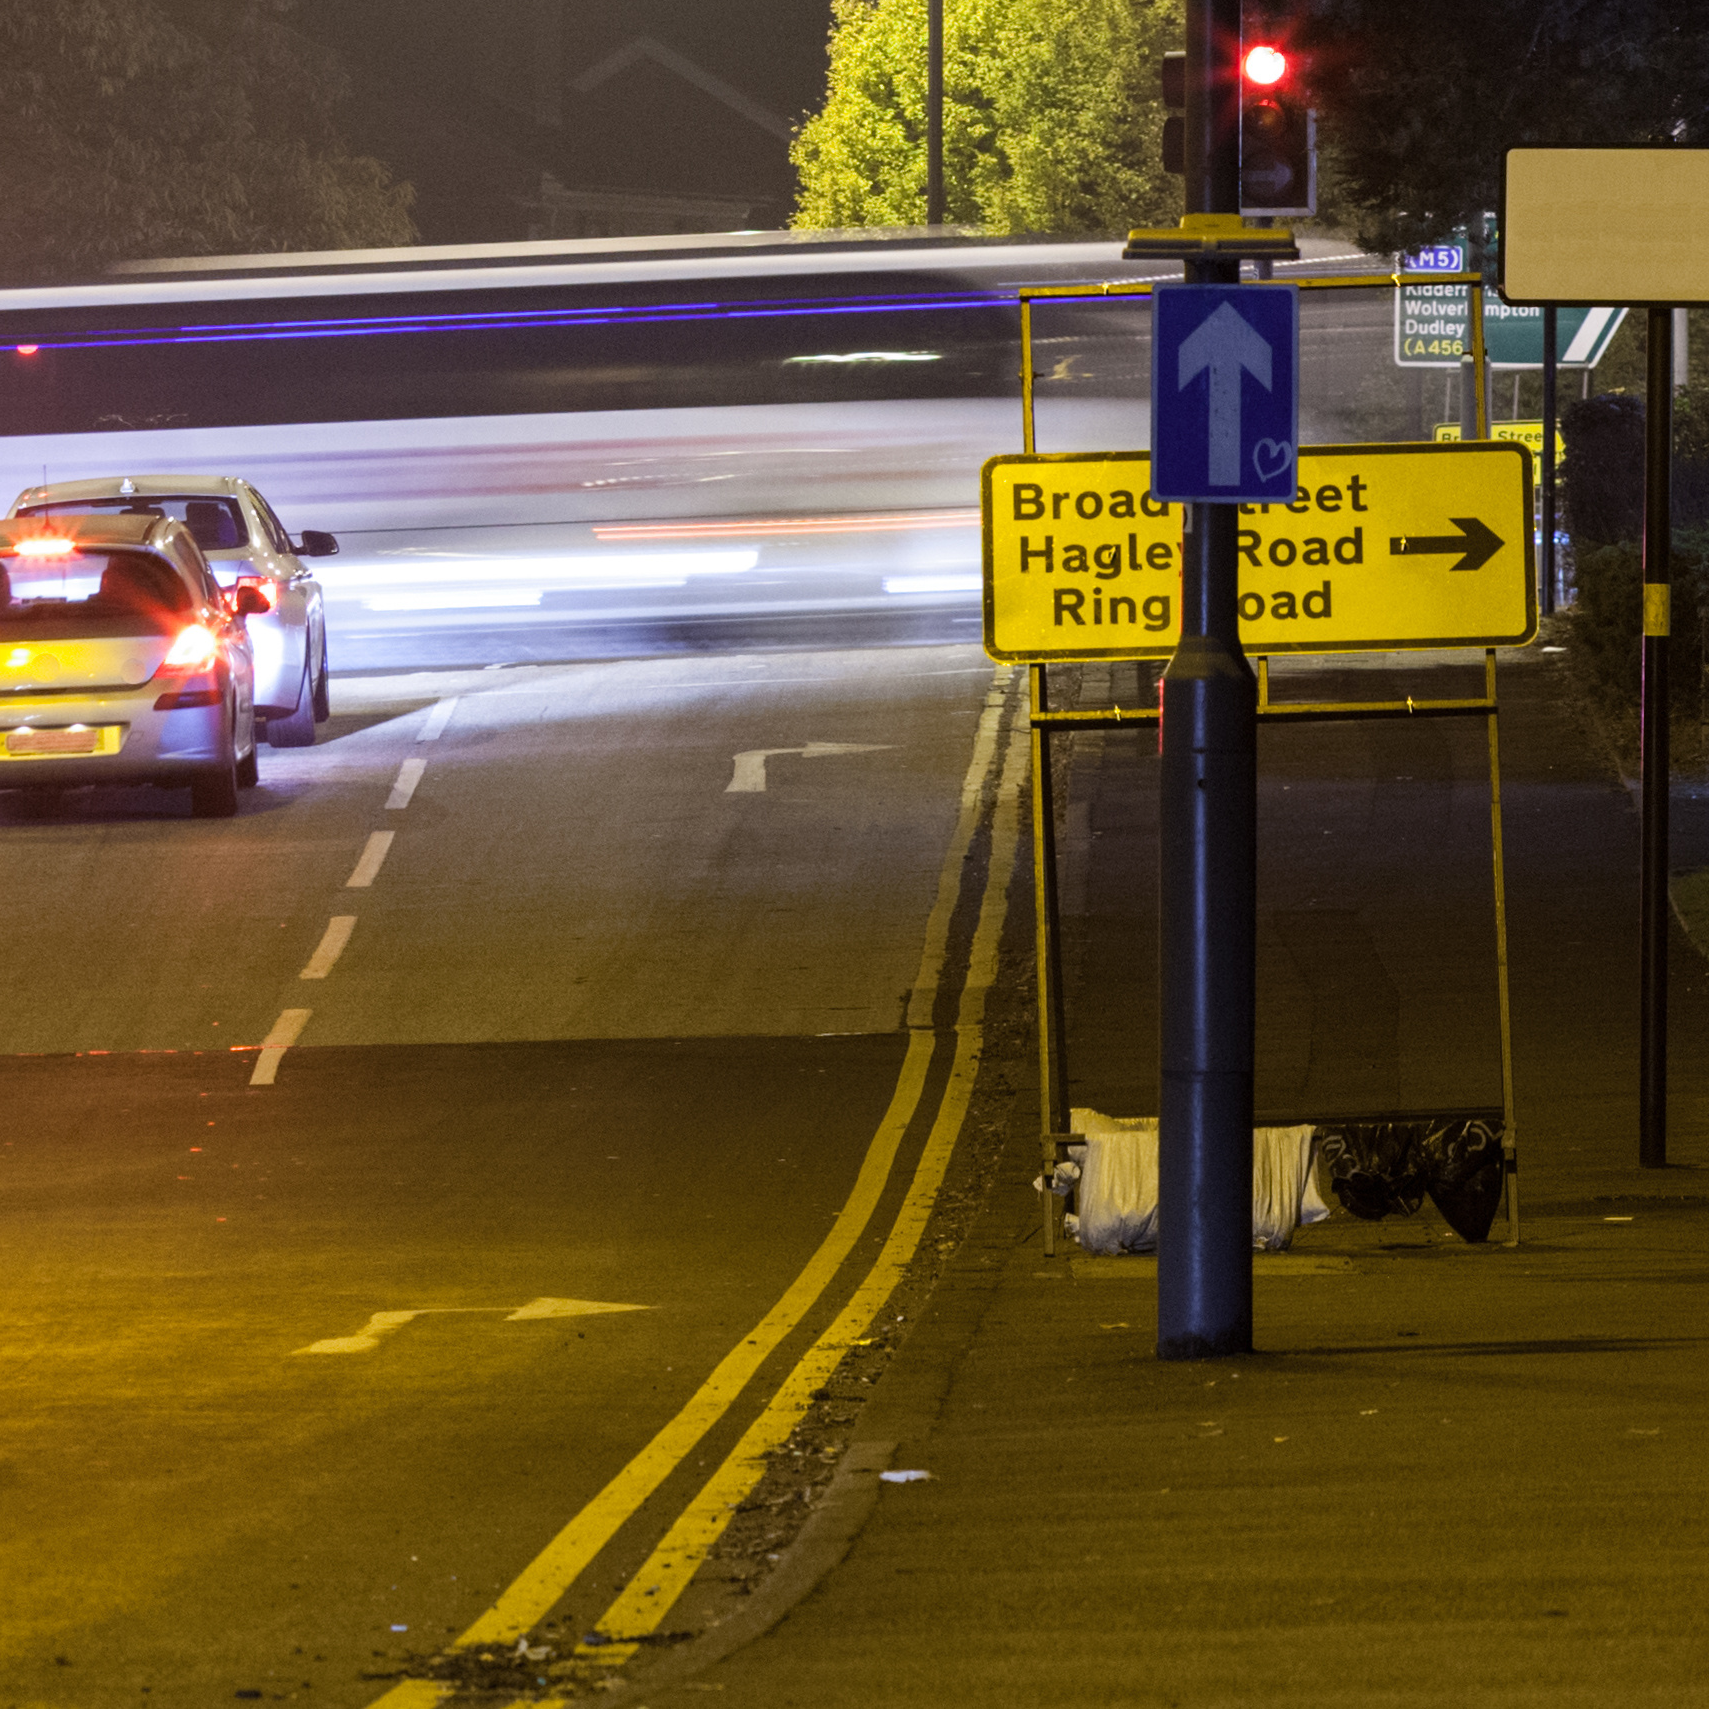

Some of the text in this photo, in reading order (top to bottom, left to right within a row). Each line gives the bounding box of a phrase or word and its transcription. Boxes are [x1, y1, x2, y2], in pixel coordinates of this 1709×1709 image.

[1408, 249, 1459, 269] (M5)
[1405, 300, 1540, 320] Wolvermpton
[1405, 319, 1466, 338] Dudley
[1498, 430, 1544, 443] Stree
[1020, 533, 1183, 580] Hagle
[1053, 580, 1333, 632] Ring oad
